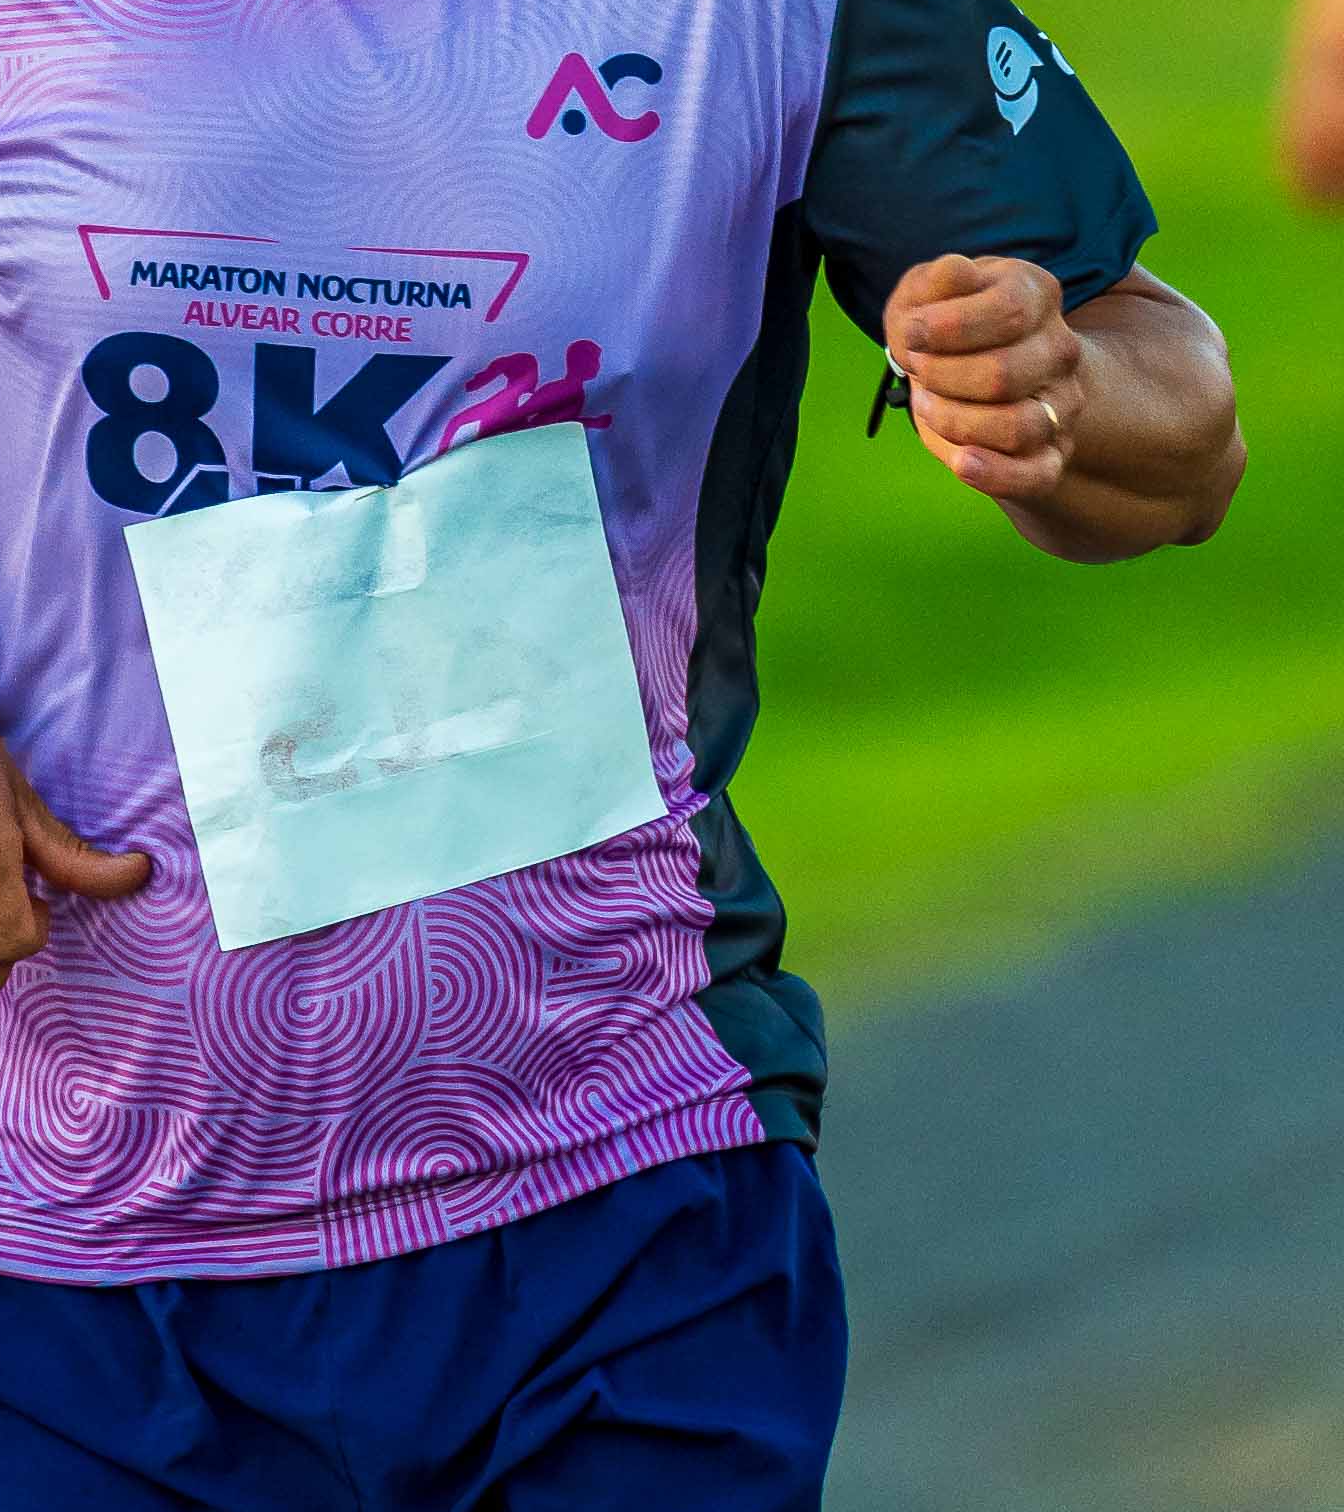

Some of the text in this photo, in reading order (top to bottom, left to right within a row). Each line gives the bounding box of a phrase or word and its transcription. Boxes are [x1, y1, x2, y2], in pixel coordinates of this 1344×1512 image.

[526, 52, 663, 143] AC
[130, 261, 472, 309] MARATON NOCTURNA
[183, 301, 413, 342] ALVEAR CORRE
[82, 331, 456, 516] 8K
